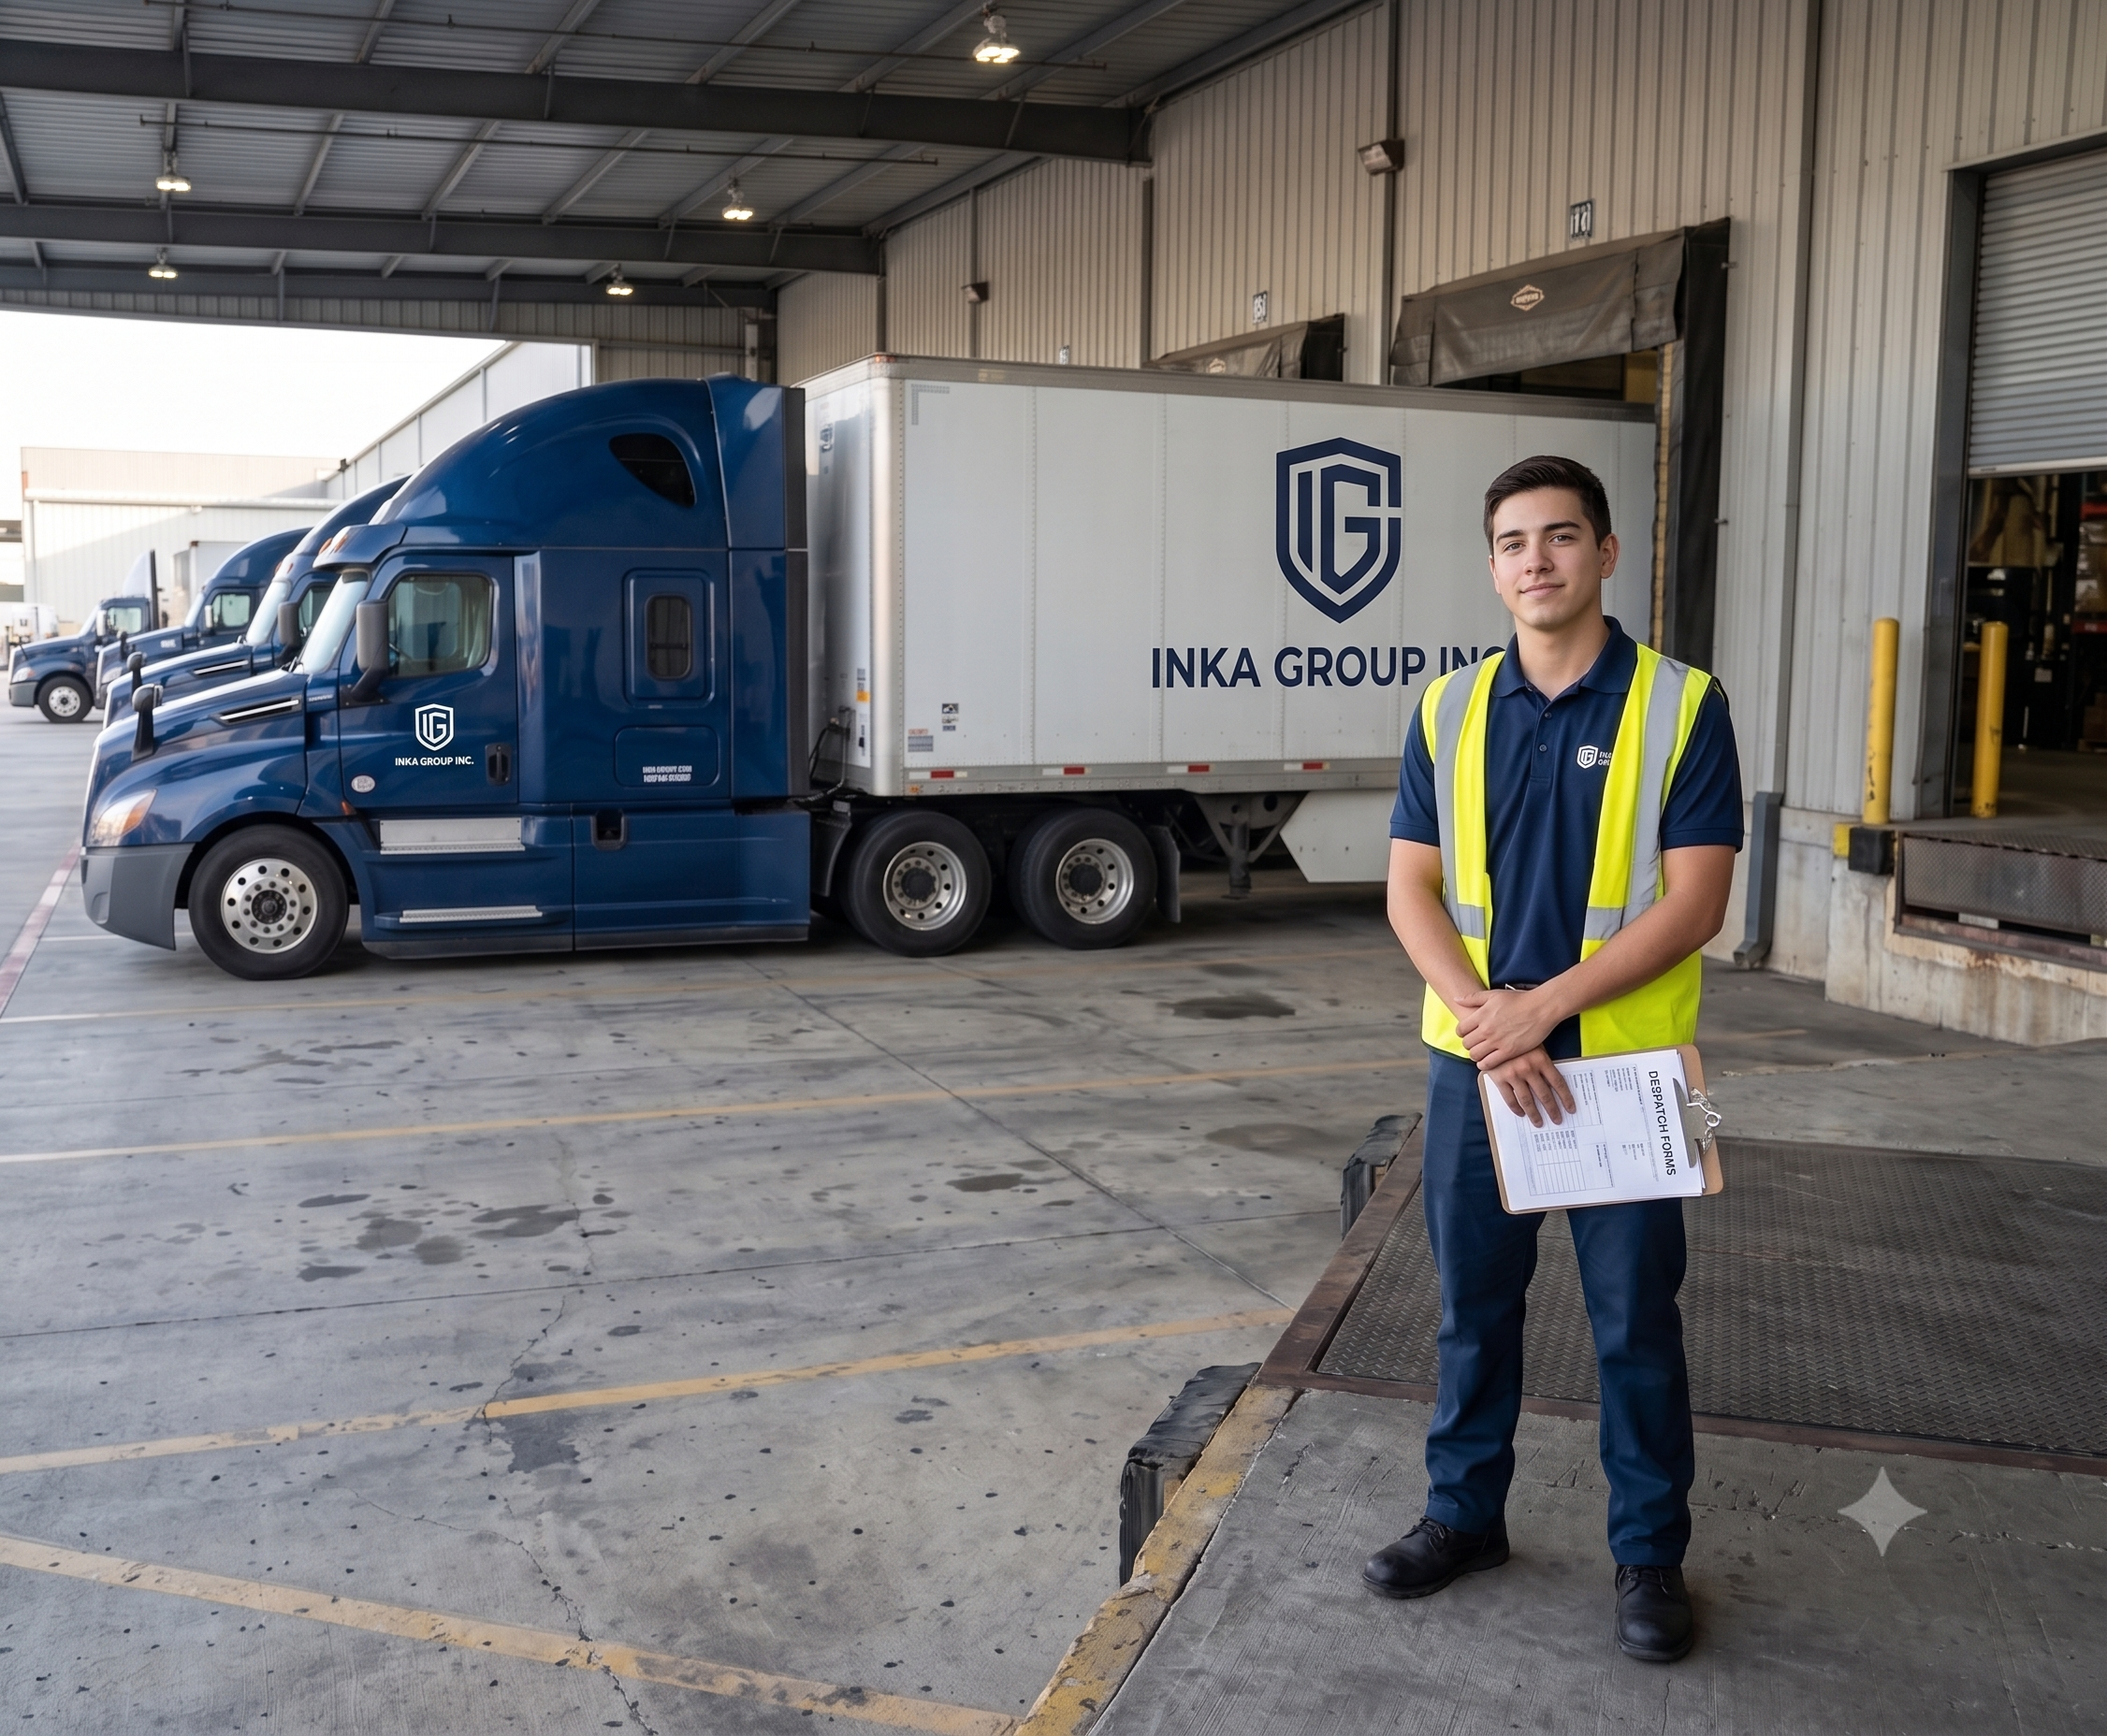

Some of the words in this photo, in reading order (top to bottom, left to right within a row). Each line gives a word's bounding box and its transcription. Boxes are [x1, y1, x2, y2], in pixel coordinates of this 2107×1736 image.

[1152, 647, 1261, 688] INKA
[1274, 646, 1426, 687] GROUP
[1440, 646, 1506, 676] IN
[395, 757, 419, 766] INKA
[420, 757, 454, 766] GROUP
[455, 756, 474, 765] INC.
[1648, 1070, 1669, 1134] DESPATCH
[1660, 1136, 1677, 1177] FORMS
